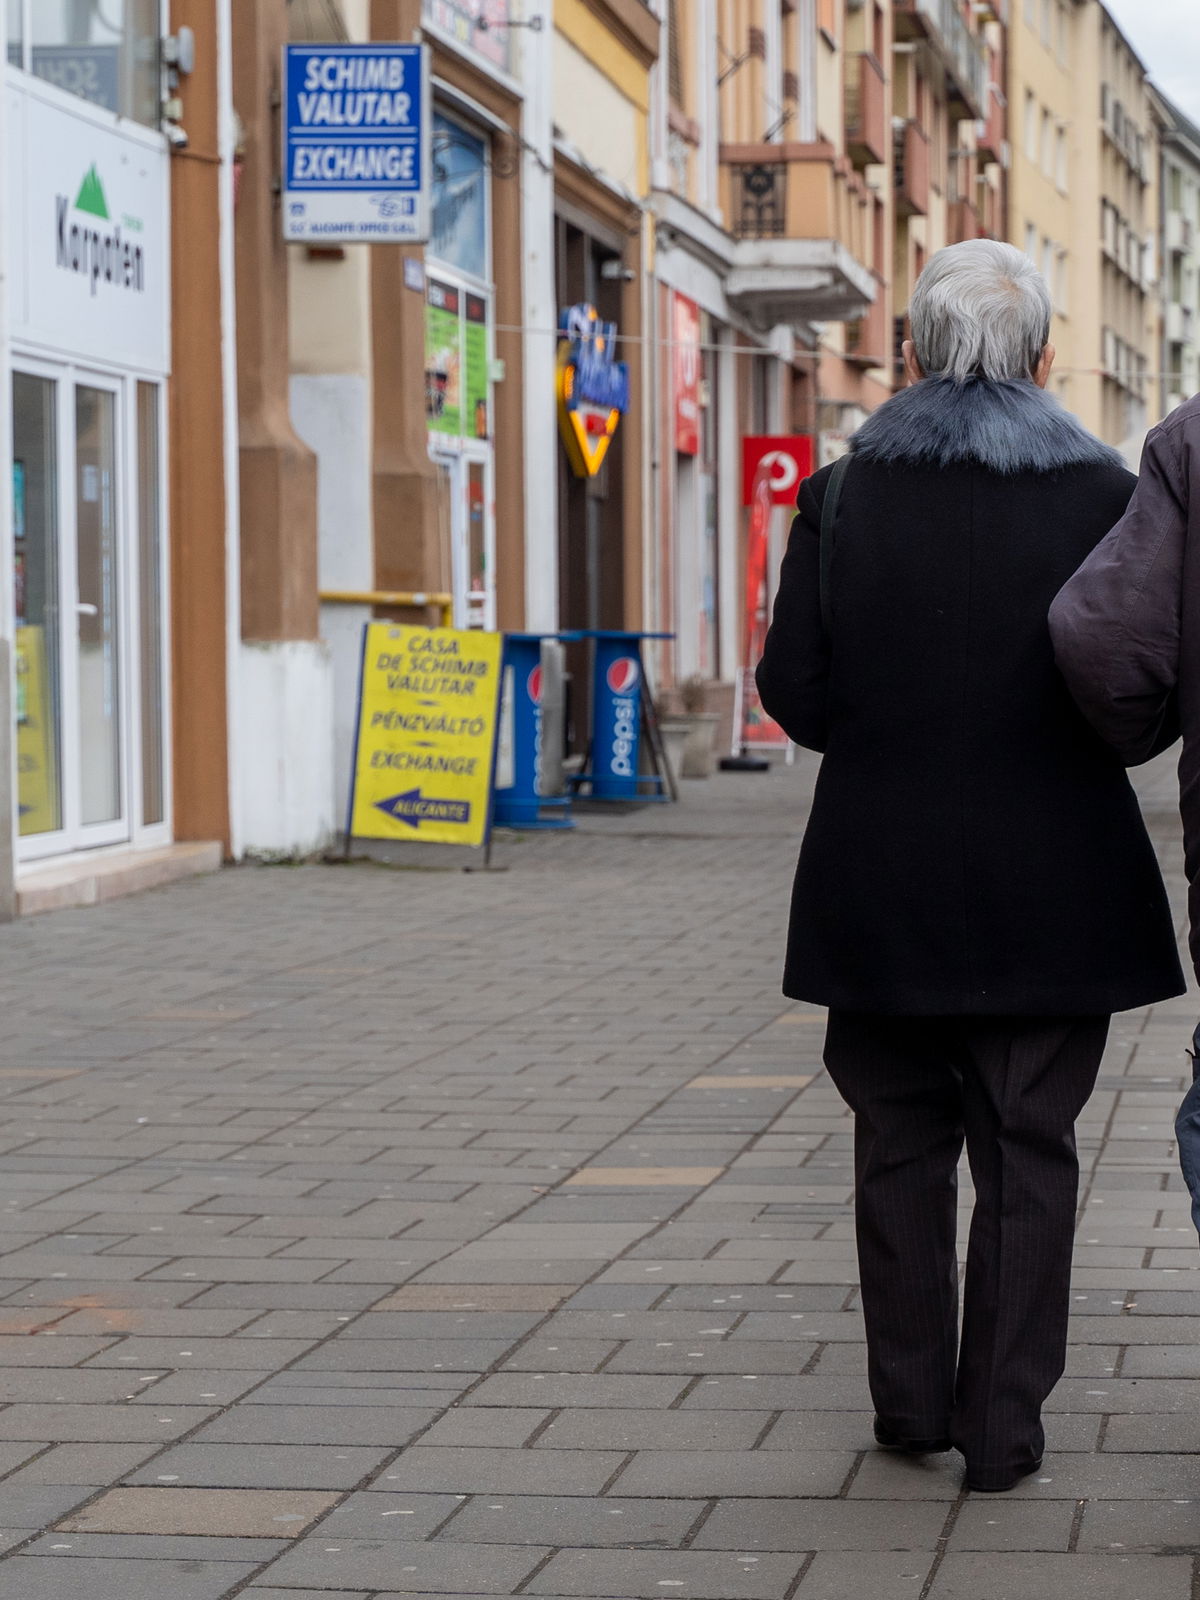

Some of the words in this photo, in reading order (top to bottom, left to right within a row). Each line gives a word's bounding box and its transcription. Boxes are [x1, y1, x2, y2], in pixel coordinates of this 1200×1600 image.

[304, 57, 404, 91] SCHIMB
[297, 91, 411, 125] VALUTAR
[293, 146, 415, 180] EXCHANGE
[56, 193, 144, 296] Karpaten
[407, 636, 460, 655] CASA
[376, 653, 402, 671] DE
[408, 656, 488, 676] SCHIMB
[387, 674, 476, 696] VALUTAR
[370, 708, 486, 737] PÉNZVÁLTÓ
[610, 697, 636, 777] pepsi
[370, 750, 478, 777] EXCHANGE
[392, 799, 466, 821] ALICANTE
